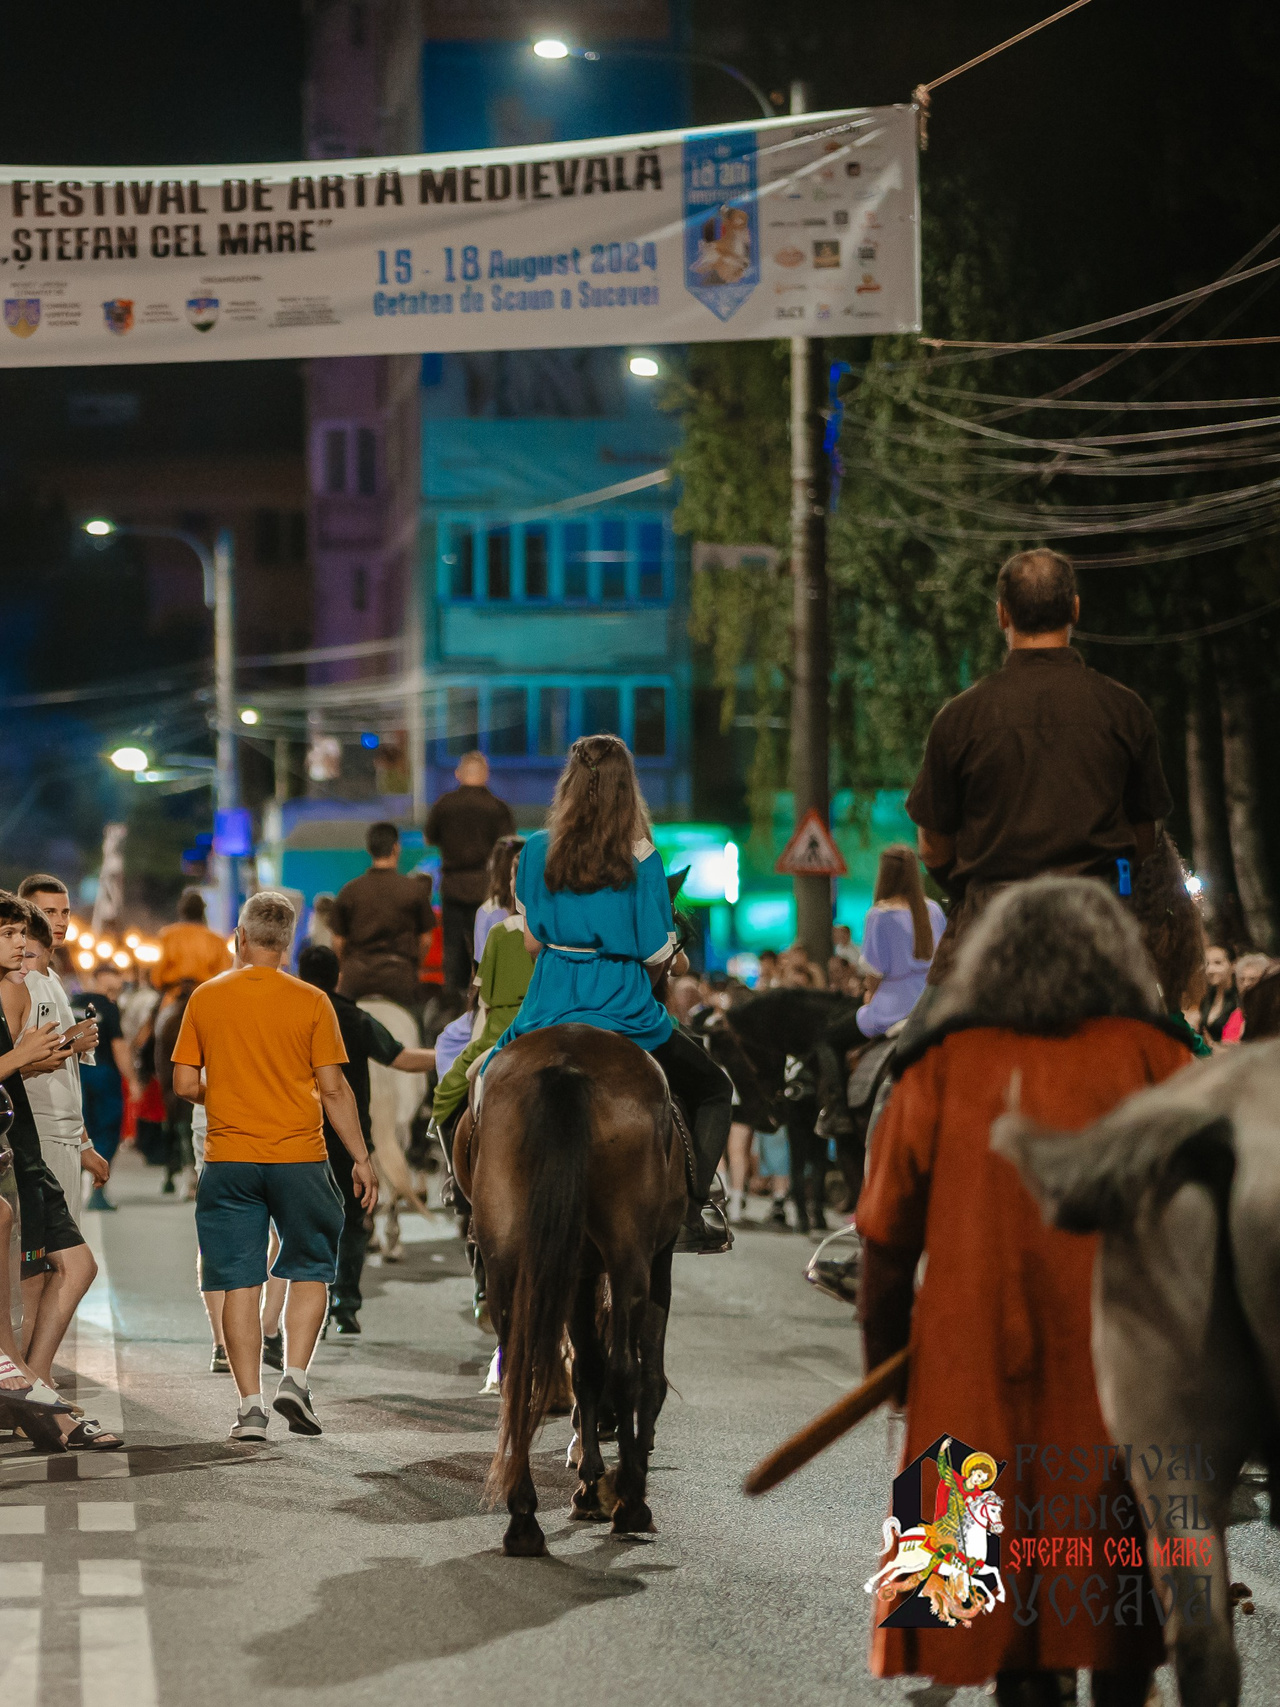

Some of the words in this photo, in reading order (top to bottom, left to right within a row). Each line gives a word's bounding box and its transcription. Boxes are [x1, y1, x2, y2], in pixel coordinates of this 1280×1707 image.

[11, 179, 207, 217] FESTIVAL
[222, 178, 273, 213] DE
[149, 224, 207, 259] CEL
[376, 248, 413, 285] 15
[443, 245, 481, 284] 18
[488, 247, 582, 283] August
[589, 241, 658, 275] 2024
